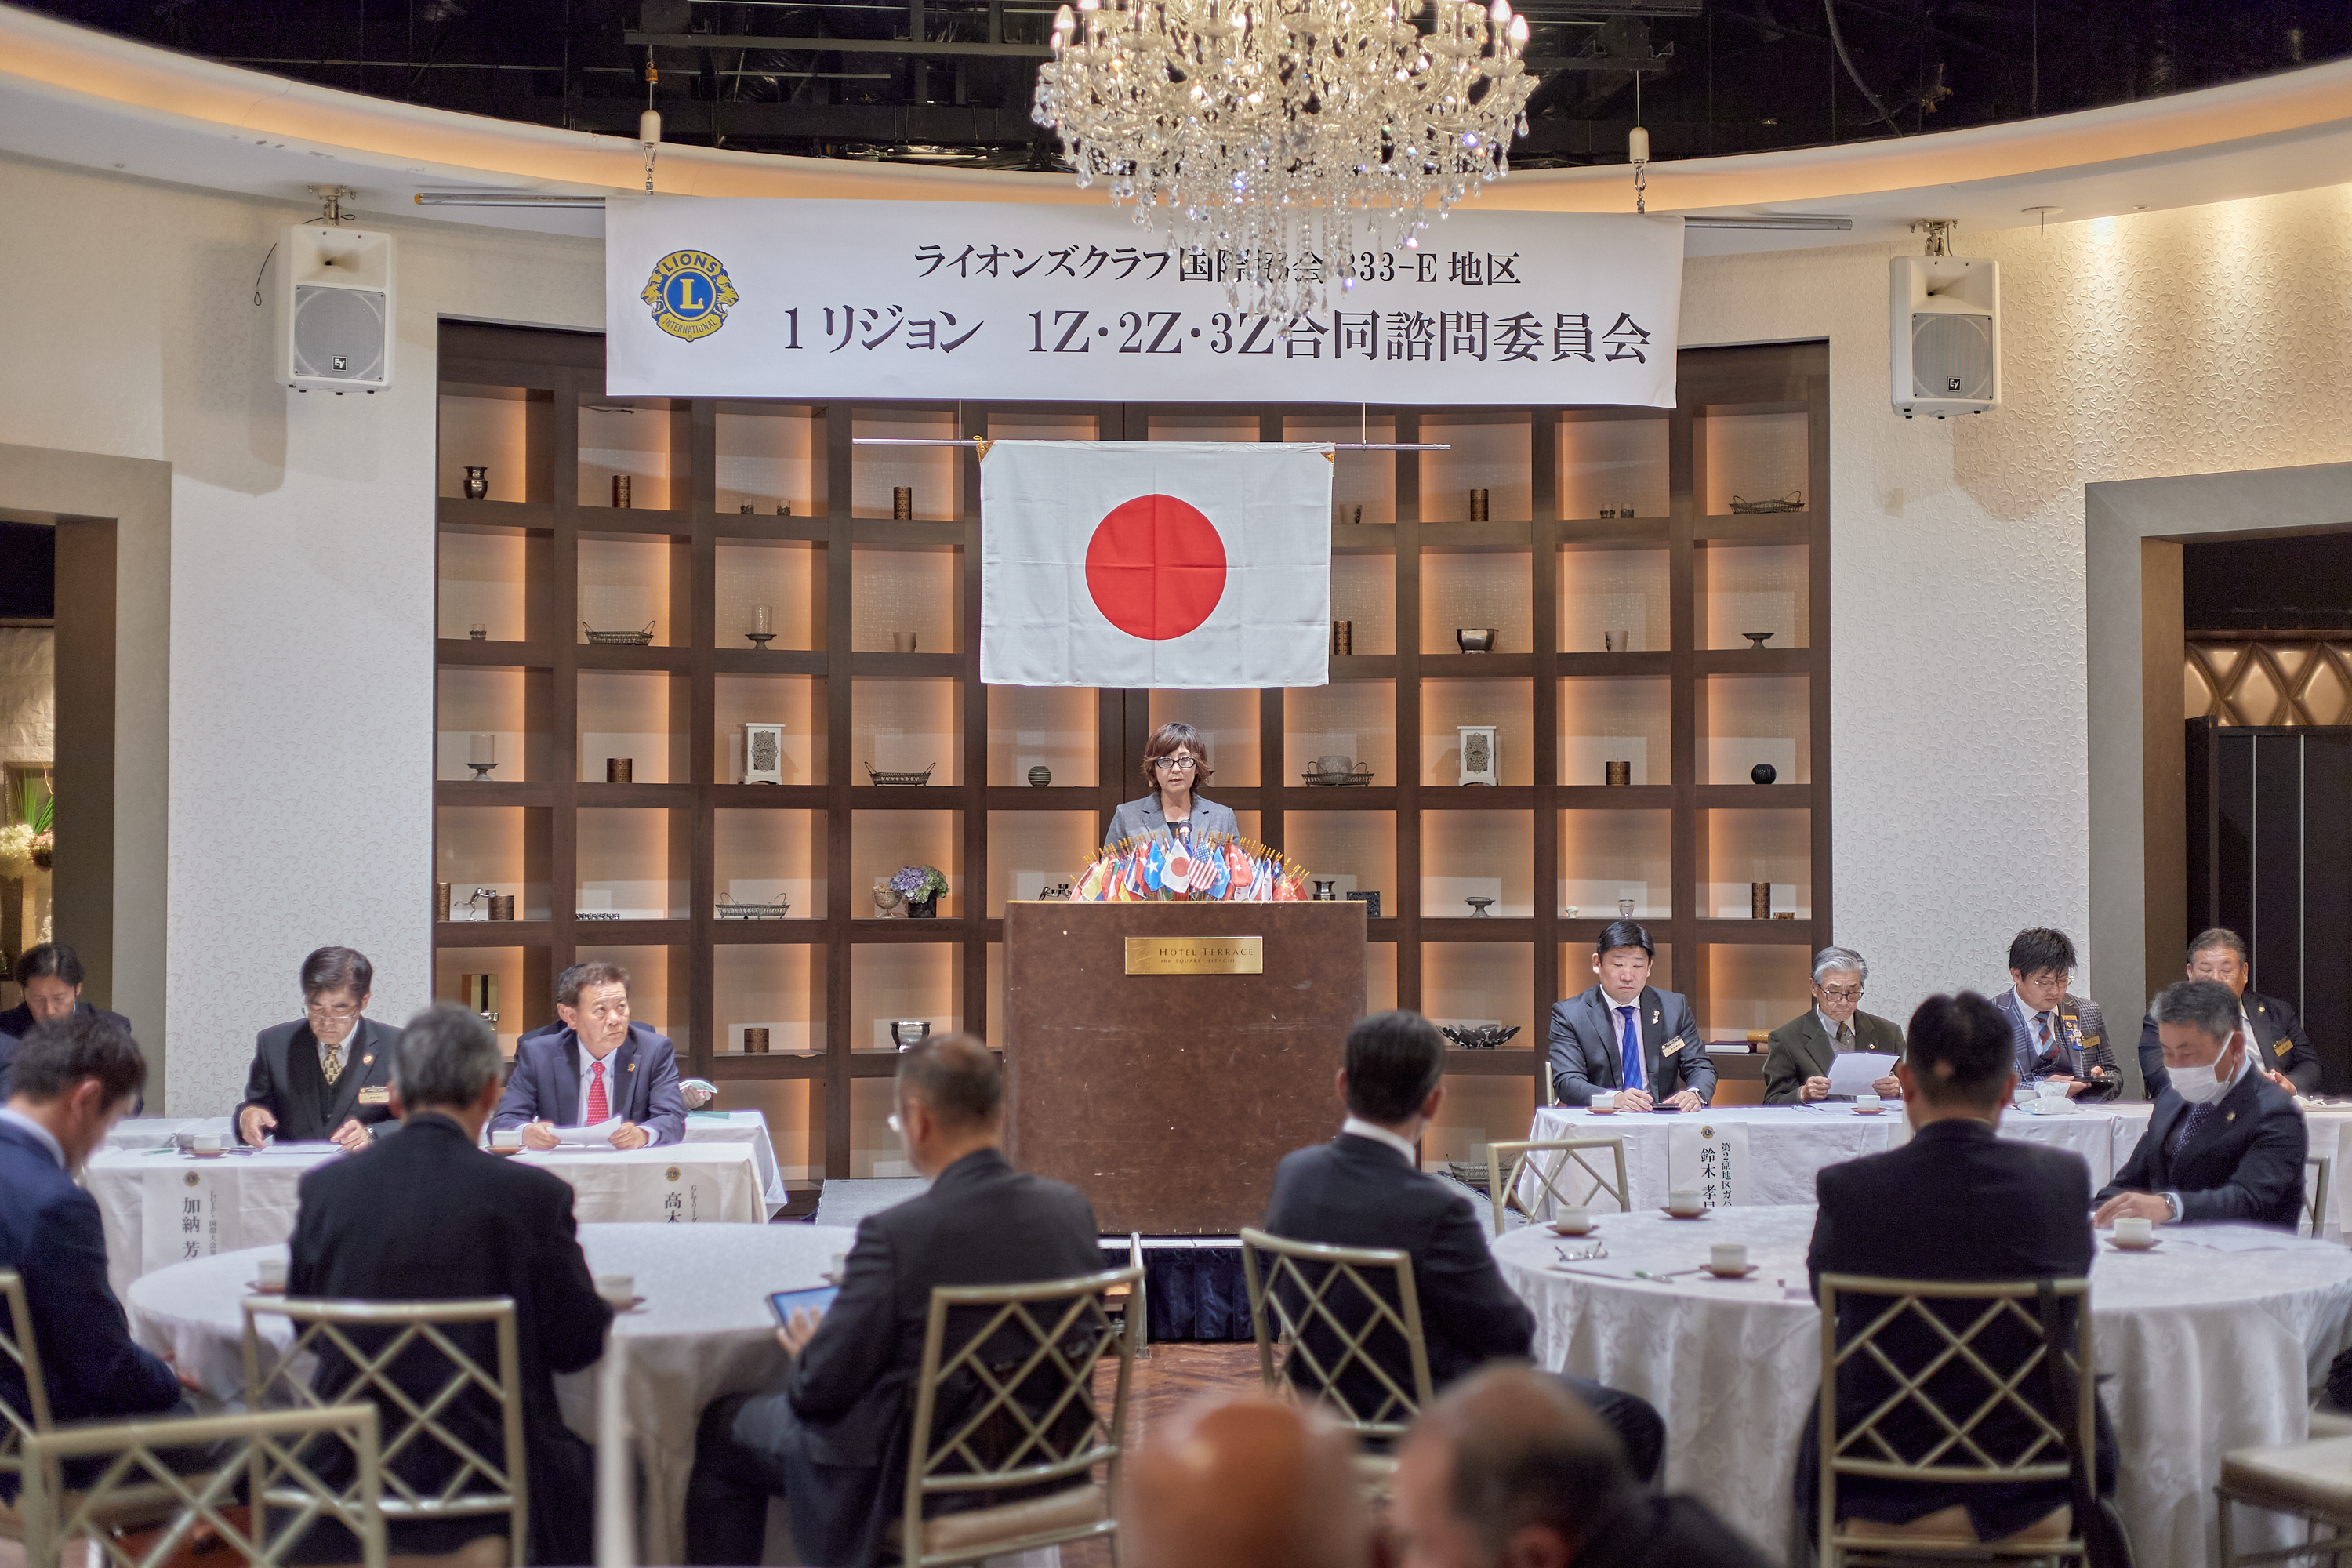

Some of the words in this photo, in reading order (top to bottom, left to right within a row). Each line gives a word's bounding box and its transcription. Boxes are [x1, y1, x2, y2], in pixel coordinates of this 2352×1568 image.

[662, 253, 718, 273] LIONS
[679, 278, 704, 309] L
[662, 317, 717, 335] INTERNATIONAL
